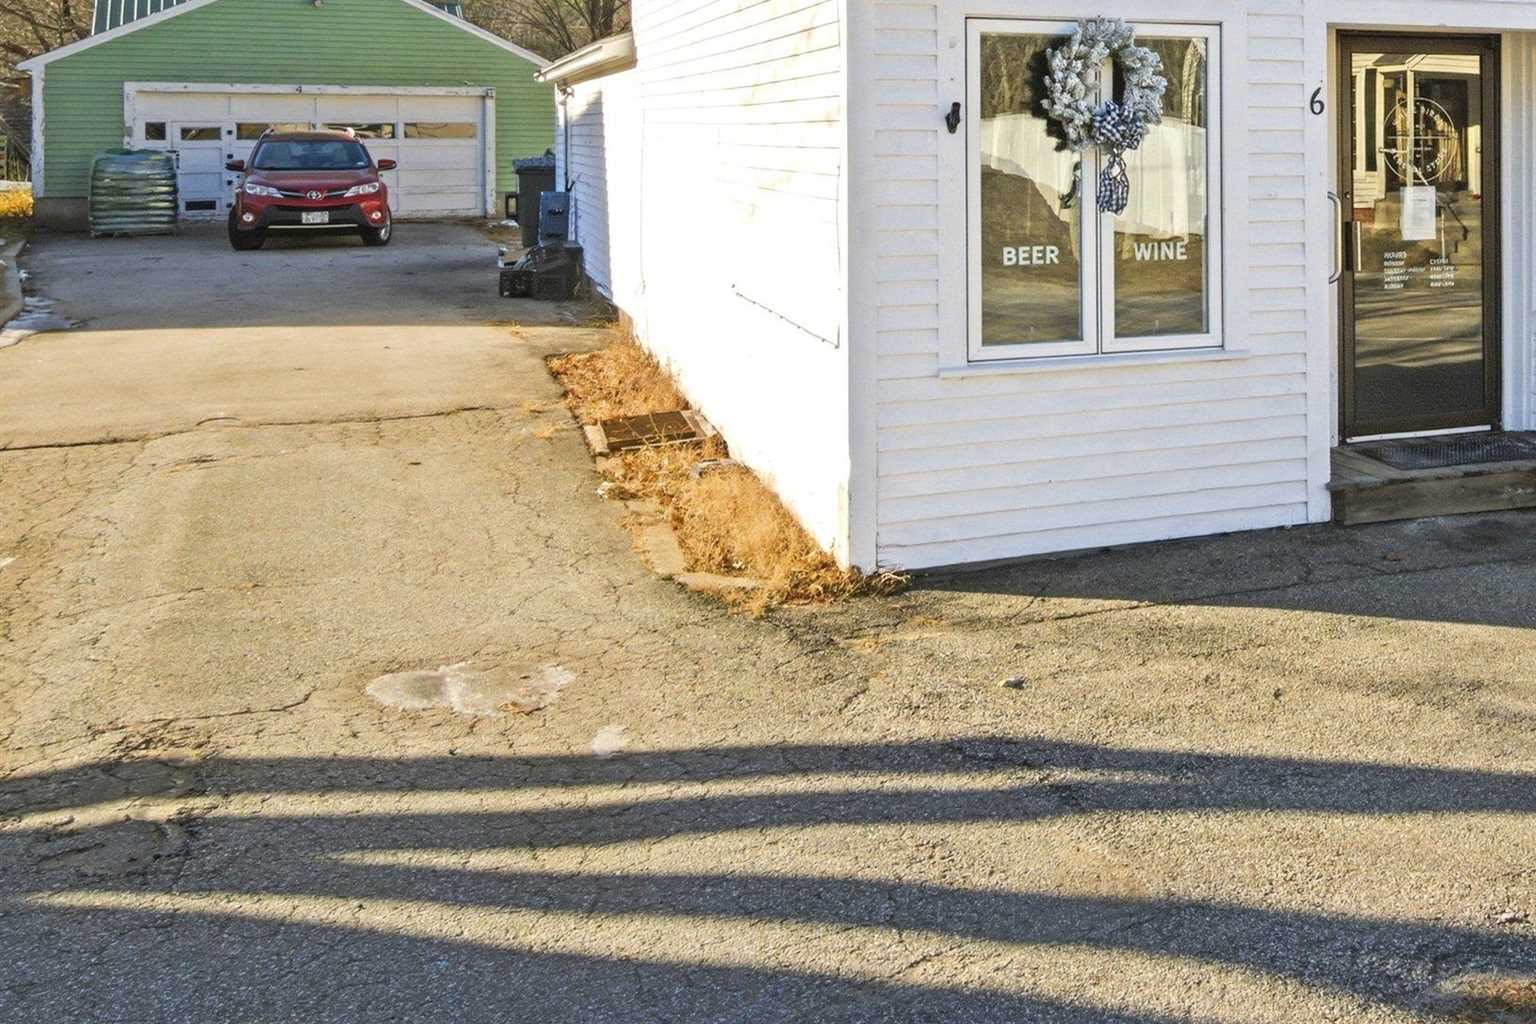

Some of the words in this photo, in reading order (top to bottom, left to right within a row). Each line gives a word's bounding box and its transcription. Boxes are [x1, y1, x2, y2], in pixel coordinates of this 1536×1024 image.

[1309, 86, 1325, 115] 6
[1002, 245, 1060, 266] BEER
[1134, 242, 1188, 261] WINE
